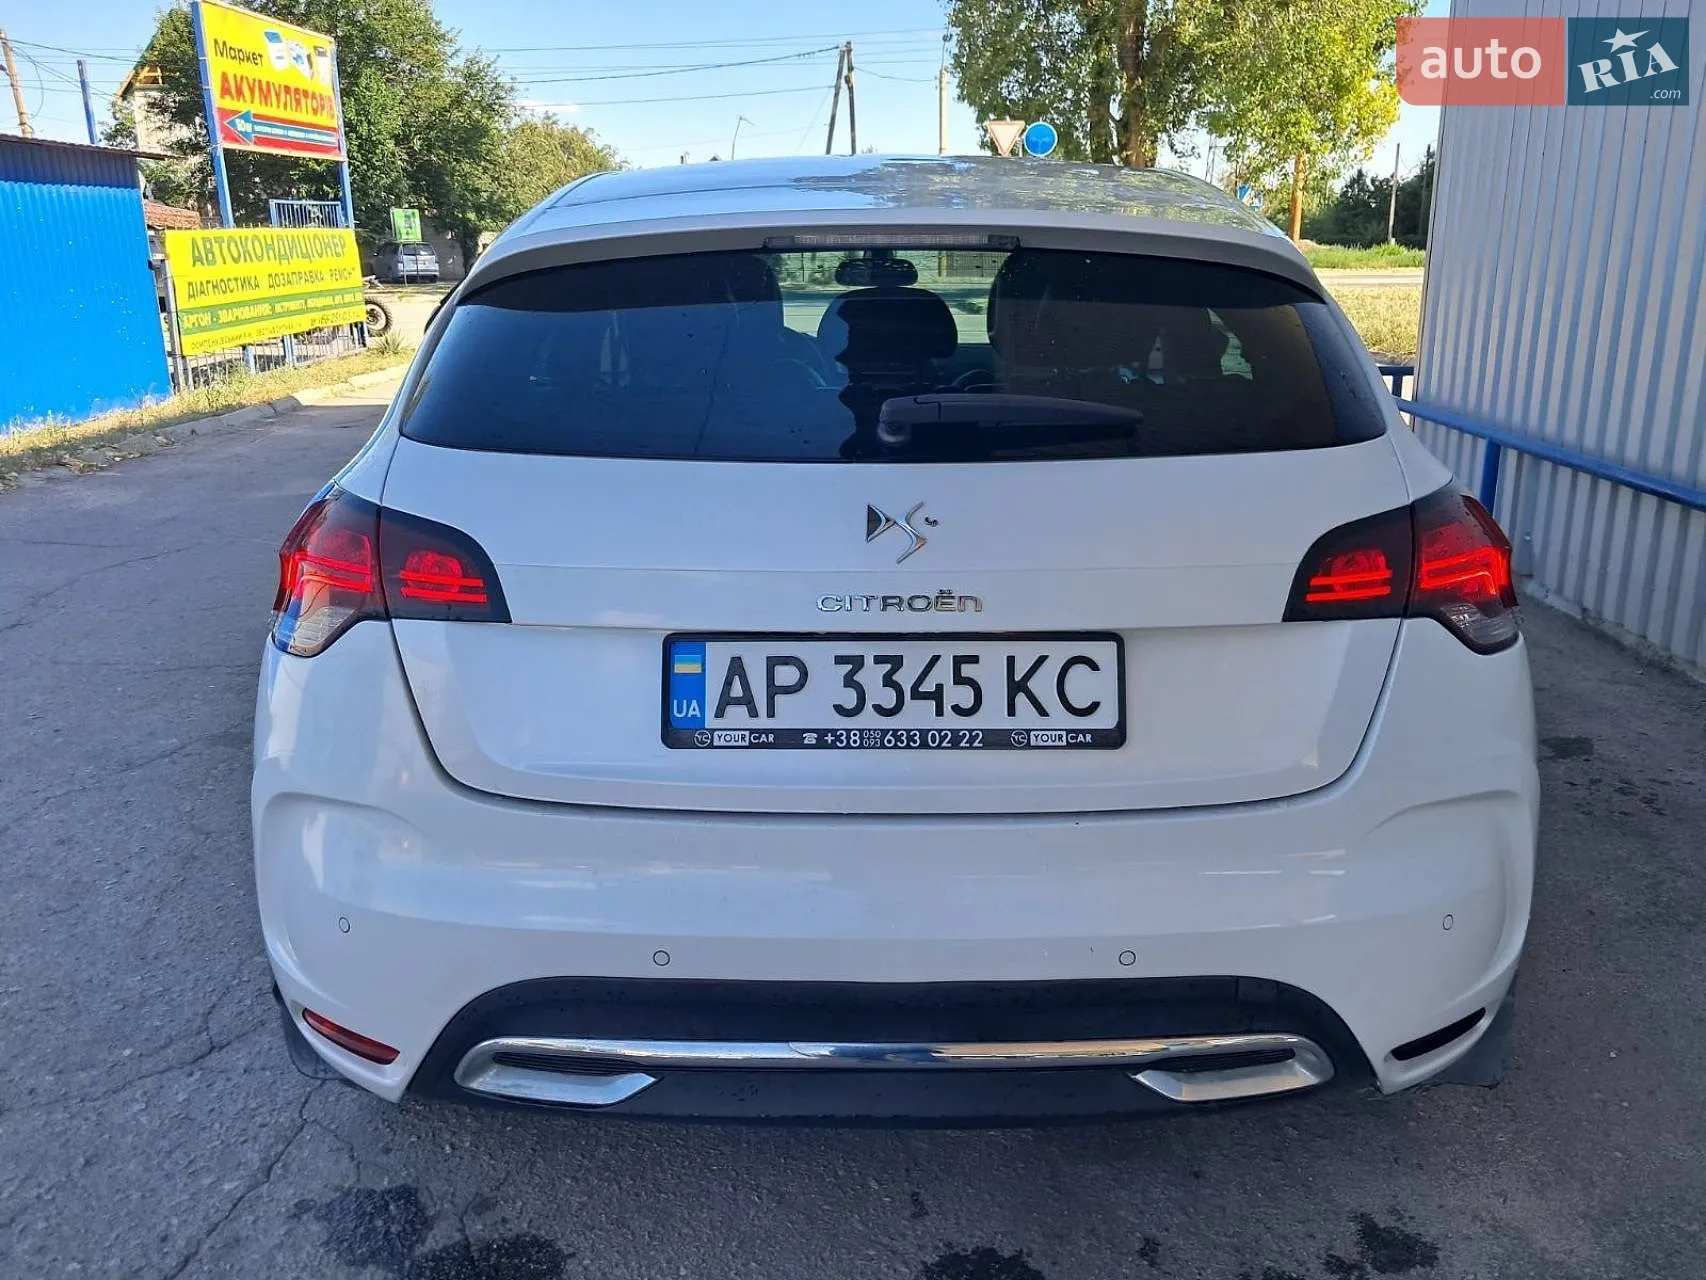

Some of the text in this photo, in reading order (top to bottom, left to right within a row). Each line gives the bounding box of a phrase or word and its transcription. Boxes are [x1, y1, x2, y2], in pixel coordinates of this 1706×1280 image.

[213, 38, 264, 67] Маркет
[219, 71, 336, 120] АКУМУЛЯТОРІВ
[191, 232, 346, 267] АВТОКОНДИЦІОНЕР
[187, 274, 260, 302] ДІАГНОСТИКА
[268, 269, 324, 291] ДОЗАПРАВКА
[713, 654, 1101, 719] AP 3345 KC
[673, 699, 702, 718] UA
[715, 732, 748, 745] YOUR
[750, 732, 775, 744] CAR
[823, 730, 861, 747] +38
[884, 730, 921, 747] 633
[927, 730, 952, 747] 02
[958, 730, 984, 747] 22
[1031, 731, 1066, 745] YOUR
[1067, 732, 1093, 744] CAR
